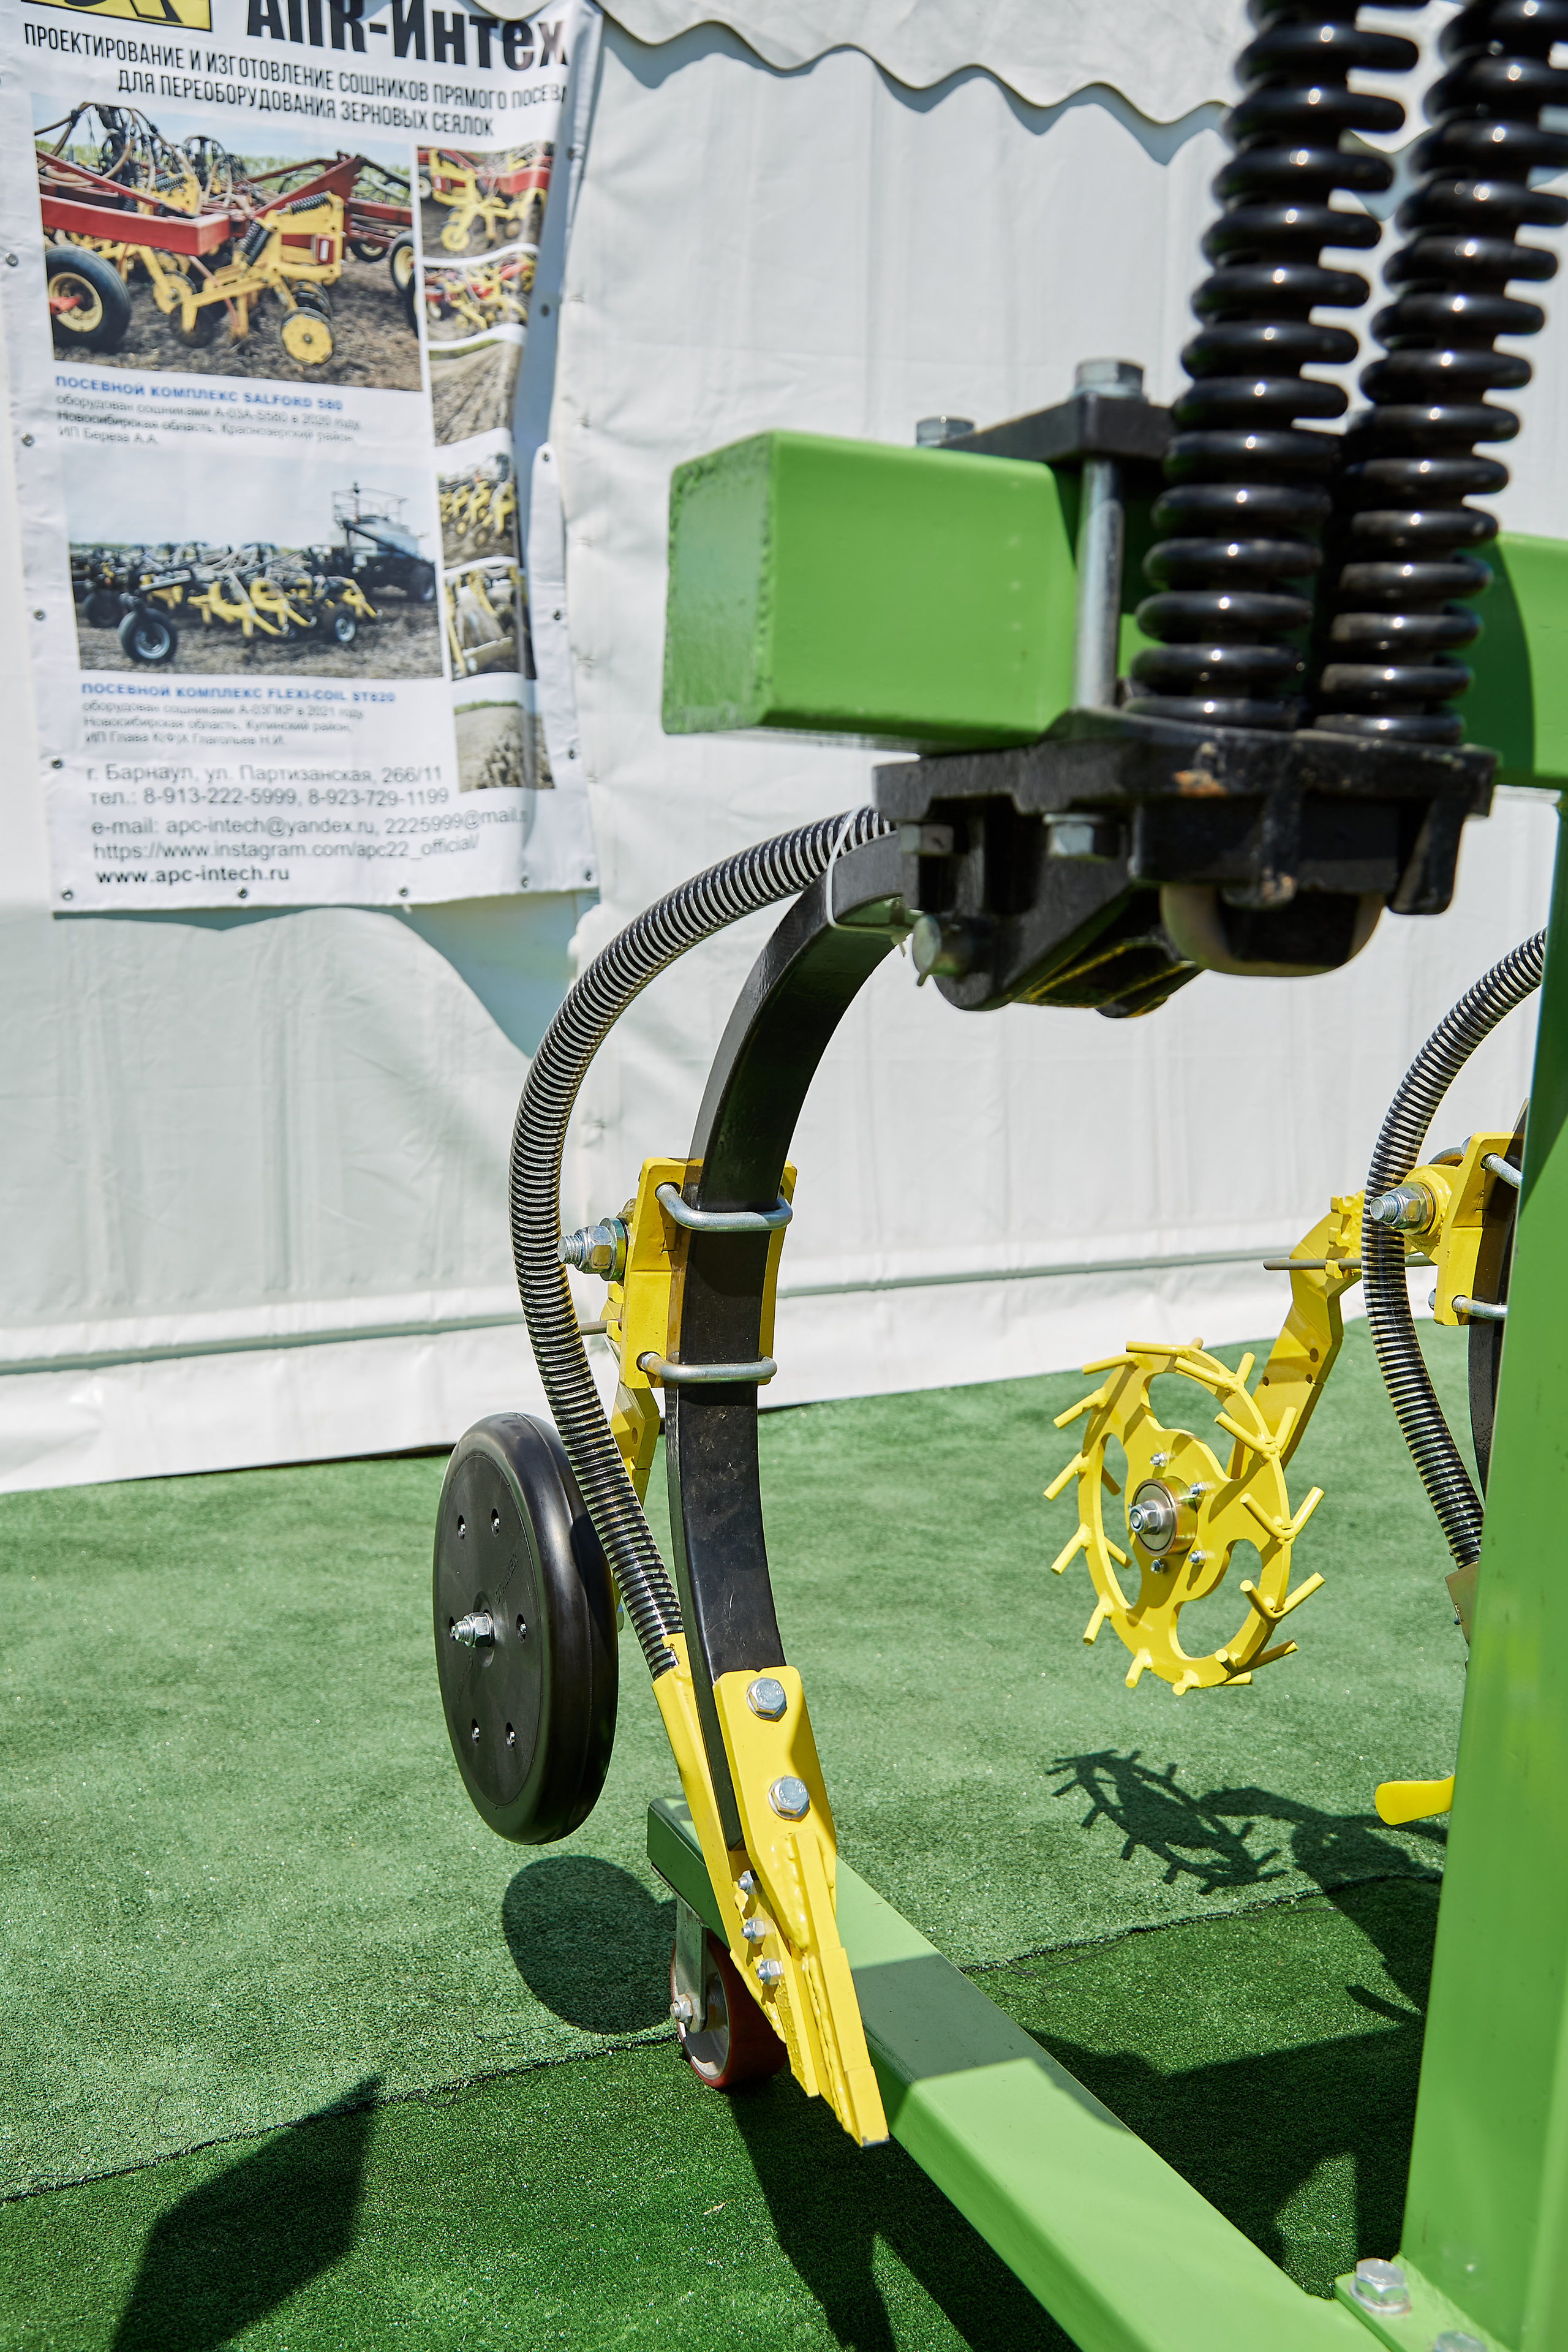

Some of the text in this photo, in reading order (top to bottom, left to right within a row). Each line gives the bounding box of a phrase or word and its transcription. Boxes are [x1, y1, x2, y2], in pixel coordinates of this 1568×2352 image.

[24, 23, 184, 69] ПРОЕКТИРОВАНИЕ
[190, 49, 201, 70] И
[206, 52, 334, 91] ИЗГОТОВЛЕНИЕ
[339, 71, 429, 102] СОШНИКОВ
[433, 83, 507, 110] ПРЯМОГО
[119, 69, 494, 136] ДЛЯ ПЕРЕОБОРУДОВАНИЯ ЗЕРНОВЫХ СЕЯЛОК
[55, 375, 343, 410] ПОСЕВНОЙ КОМПЛЕКС SALFORD 580
[57, 393, 133, 411] оборудован
[137, 404, 209, 417] сошниками
[57, 410, 159, 429] Новосибирская
[58, 426, 80, 437] ИП
[81, 683, 170, 697] ПОСЕВНОЙ
[175, 687, 262, 698] КОМПЛЕКС
[268, 688, 347, 700] FLEXI-COIL
[82, 700, 159, 714] оборудован
[164, 704, 235, 715] сошниками
[307, 705, 335, 717] 2021
[83, 715, 184, 729] Новосибирская
[85, 731, 107, 744] ИП
[110, 731, 149, 742] Глава
[87, 764, 442, 784] г. Барнаул, ул. Партизанская, 266/11
[89, 786, 448, 807] тел.: 8-913-222-5999, 8-923-729-1199
[92, 816, 159, 835] e-mail:
[165, 816, 380, 837] apc-intech@yandex.ru,
[96, 865, 290, 886] www.apc-intech.ru
